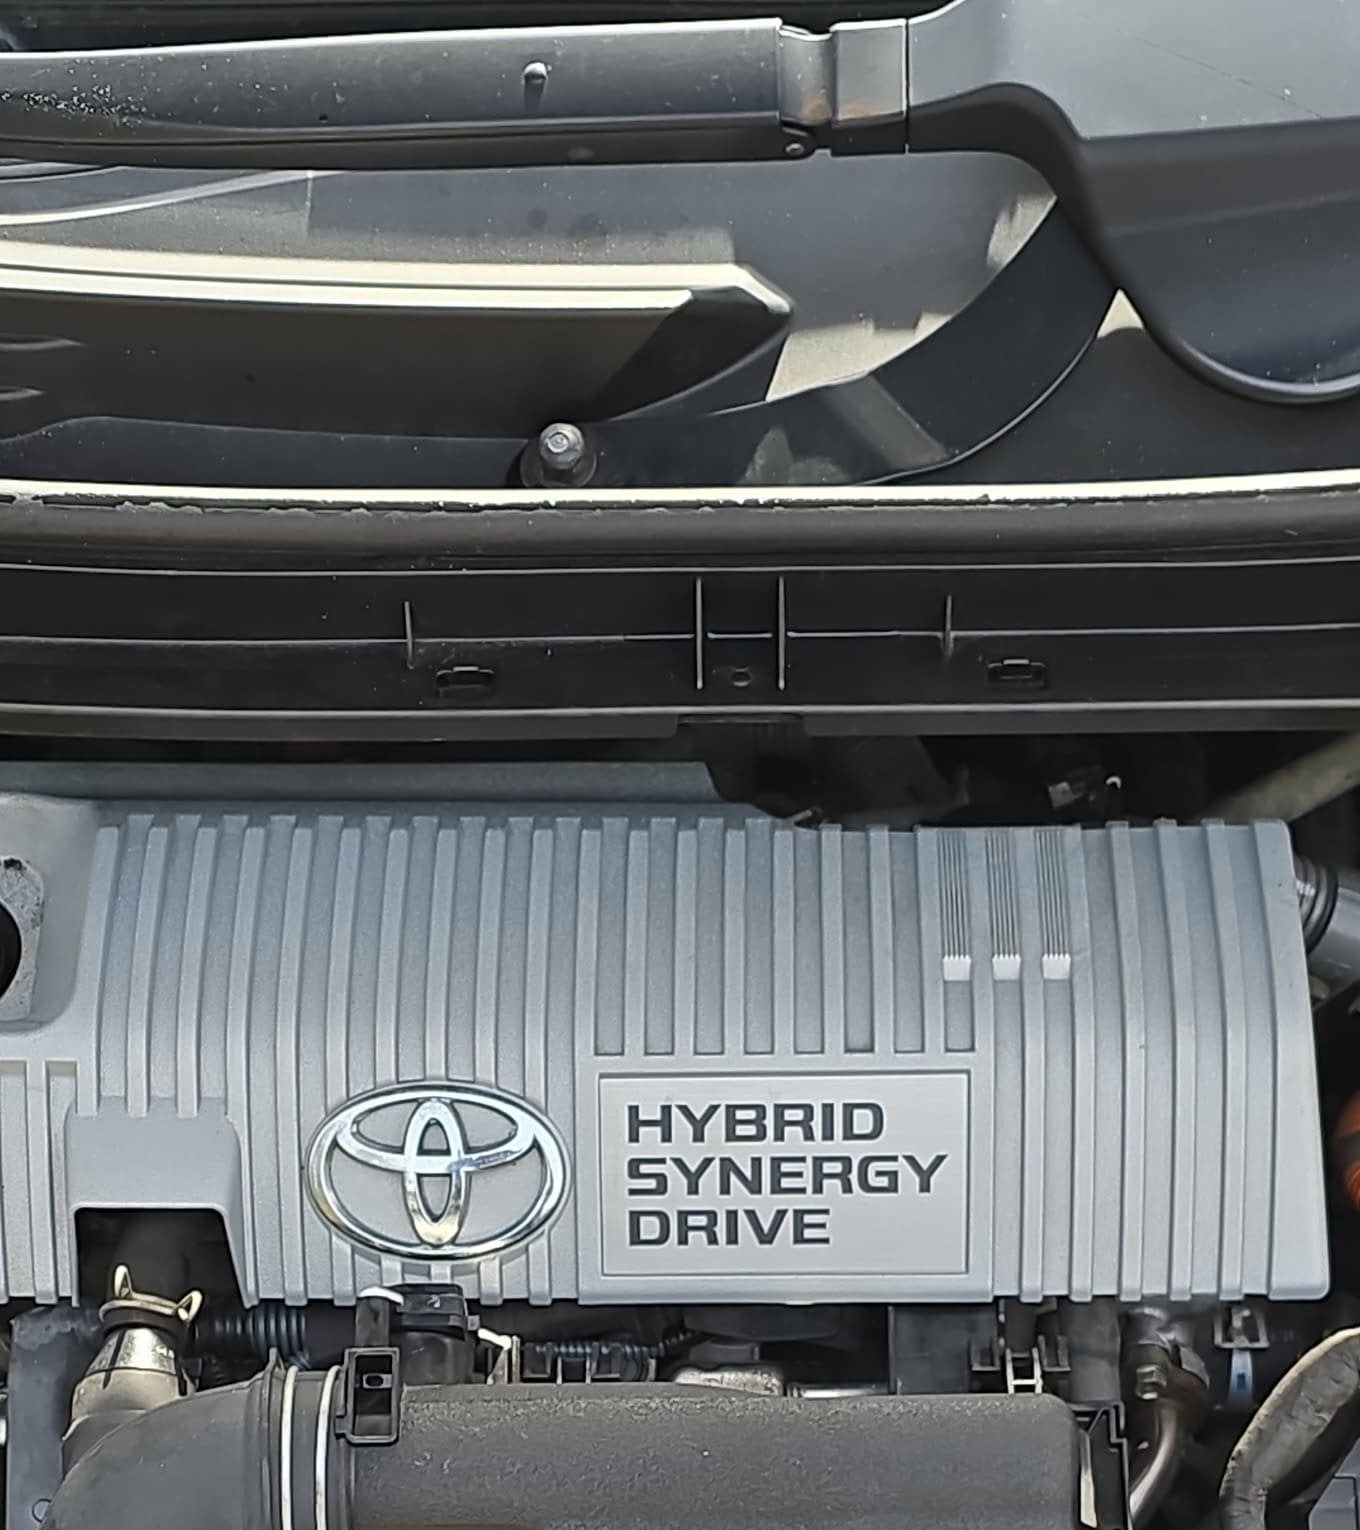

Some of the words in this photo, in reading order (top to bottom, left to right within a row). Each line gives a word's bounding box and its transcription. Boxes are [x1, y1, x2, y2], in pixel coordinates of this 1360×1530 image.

[627, 1102, 884, 1144] HYBRID
[627, 1154, 948, 1197] SYNERGY
[628, 1208, 831, 1247] DRIVE
